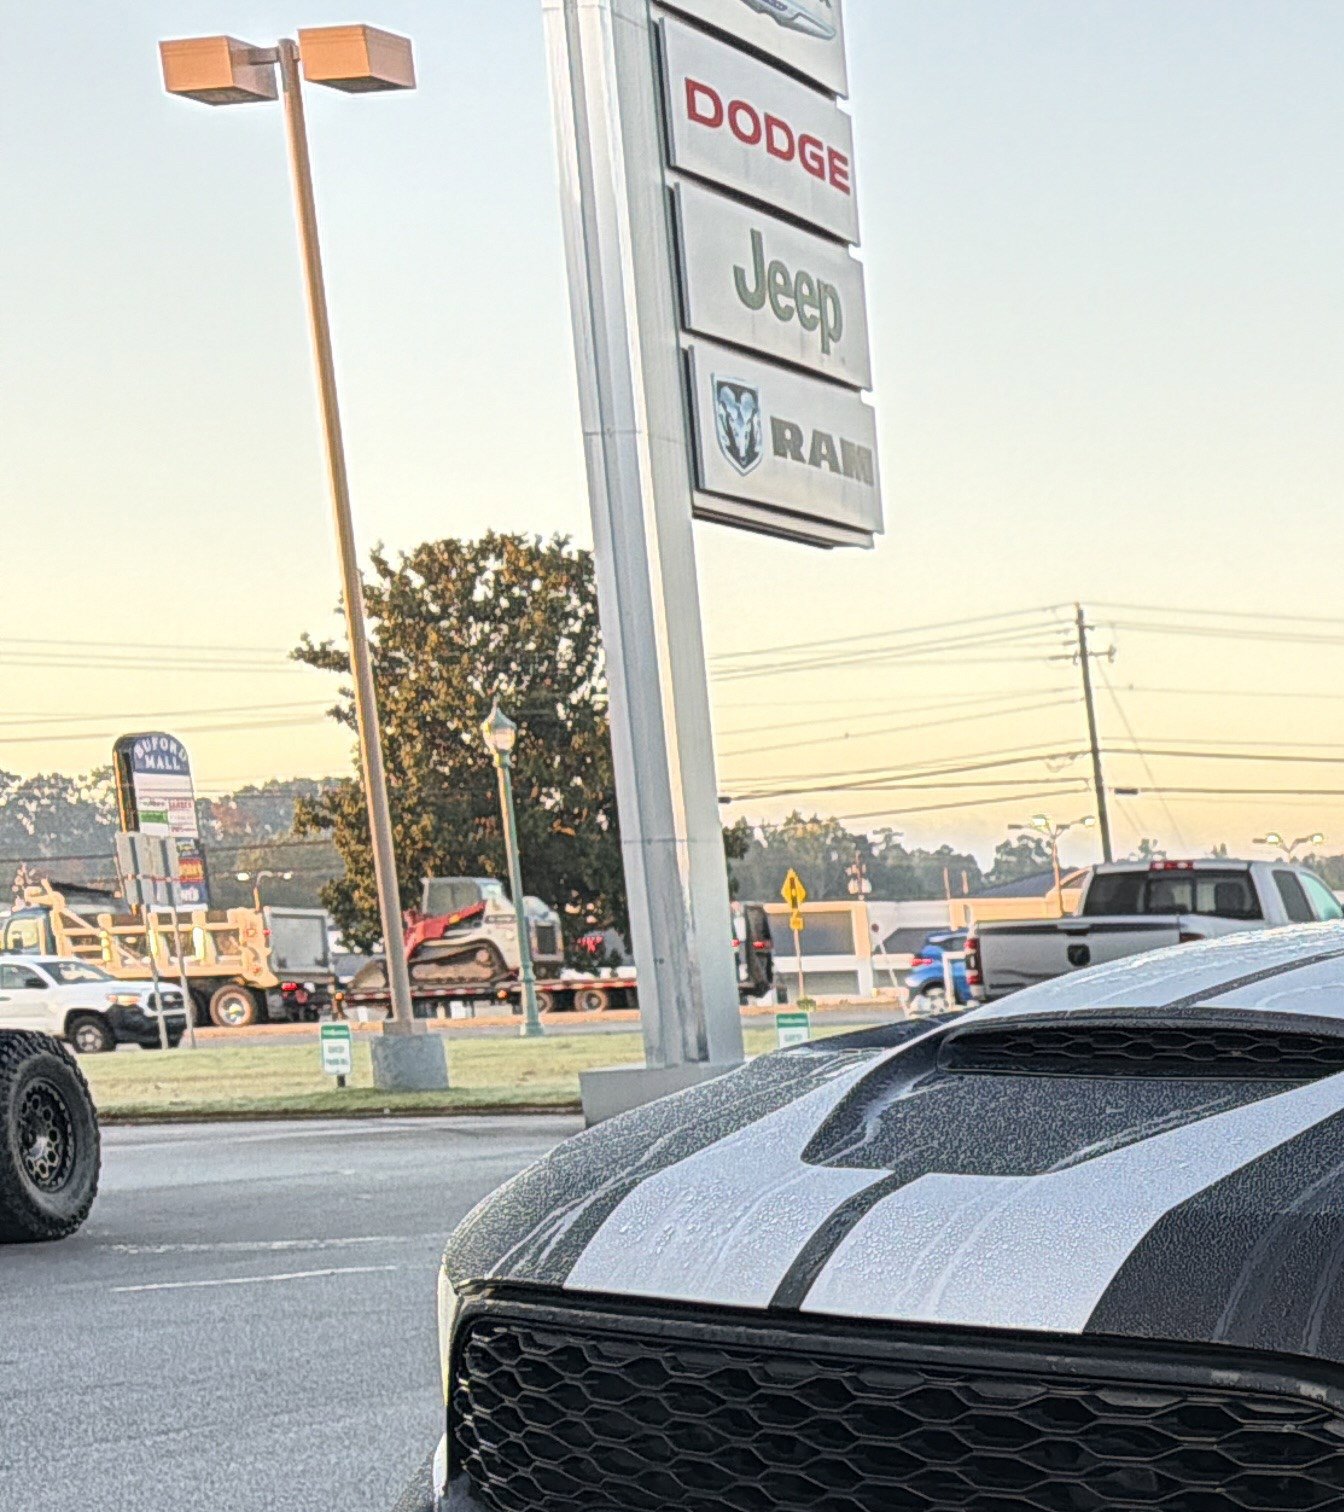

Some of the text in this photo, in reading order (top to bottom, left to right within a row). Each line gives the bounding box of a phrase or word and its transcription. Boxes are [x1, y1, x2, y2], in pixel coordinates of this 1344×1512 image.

[684, 77, 851, 195] DODGE
[733, 228, 843, 354] Jeep
[769, 415, 875, 486] RAM
[134, 736, 187, 762] BUFORD
[144, 753, 181, 770] MALL
